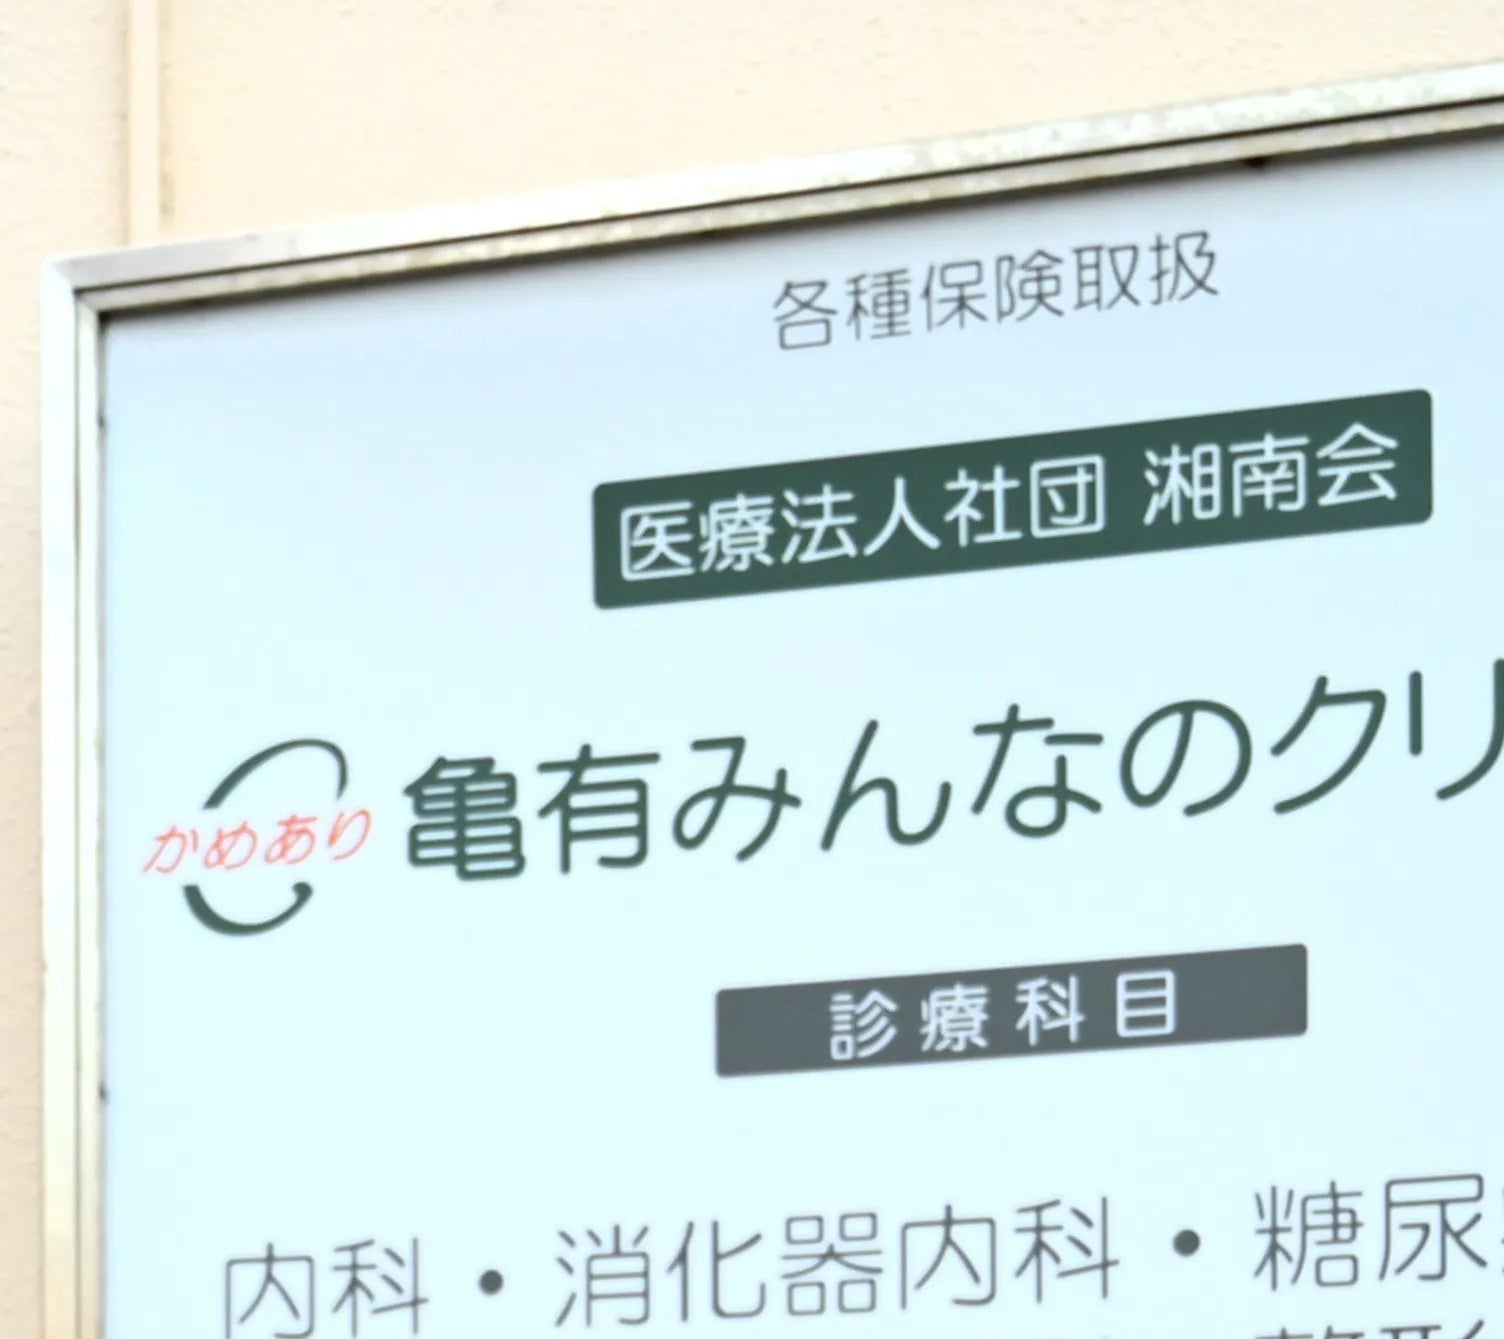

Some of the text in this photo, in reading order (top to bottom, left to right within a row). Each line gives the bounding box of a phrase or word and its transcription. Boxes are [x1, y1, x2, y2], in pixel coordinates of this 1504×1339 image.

[773, 230, 1219, 350] 各種保険取扱
[619, 421, 1398, 582] 医療法人社団 湘南会
[144, 808, 372, 873] かめあり
[828, 968, 1181, 1058] 診療科目
